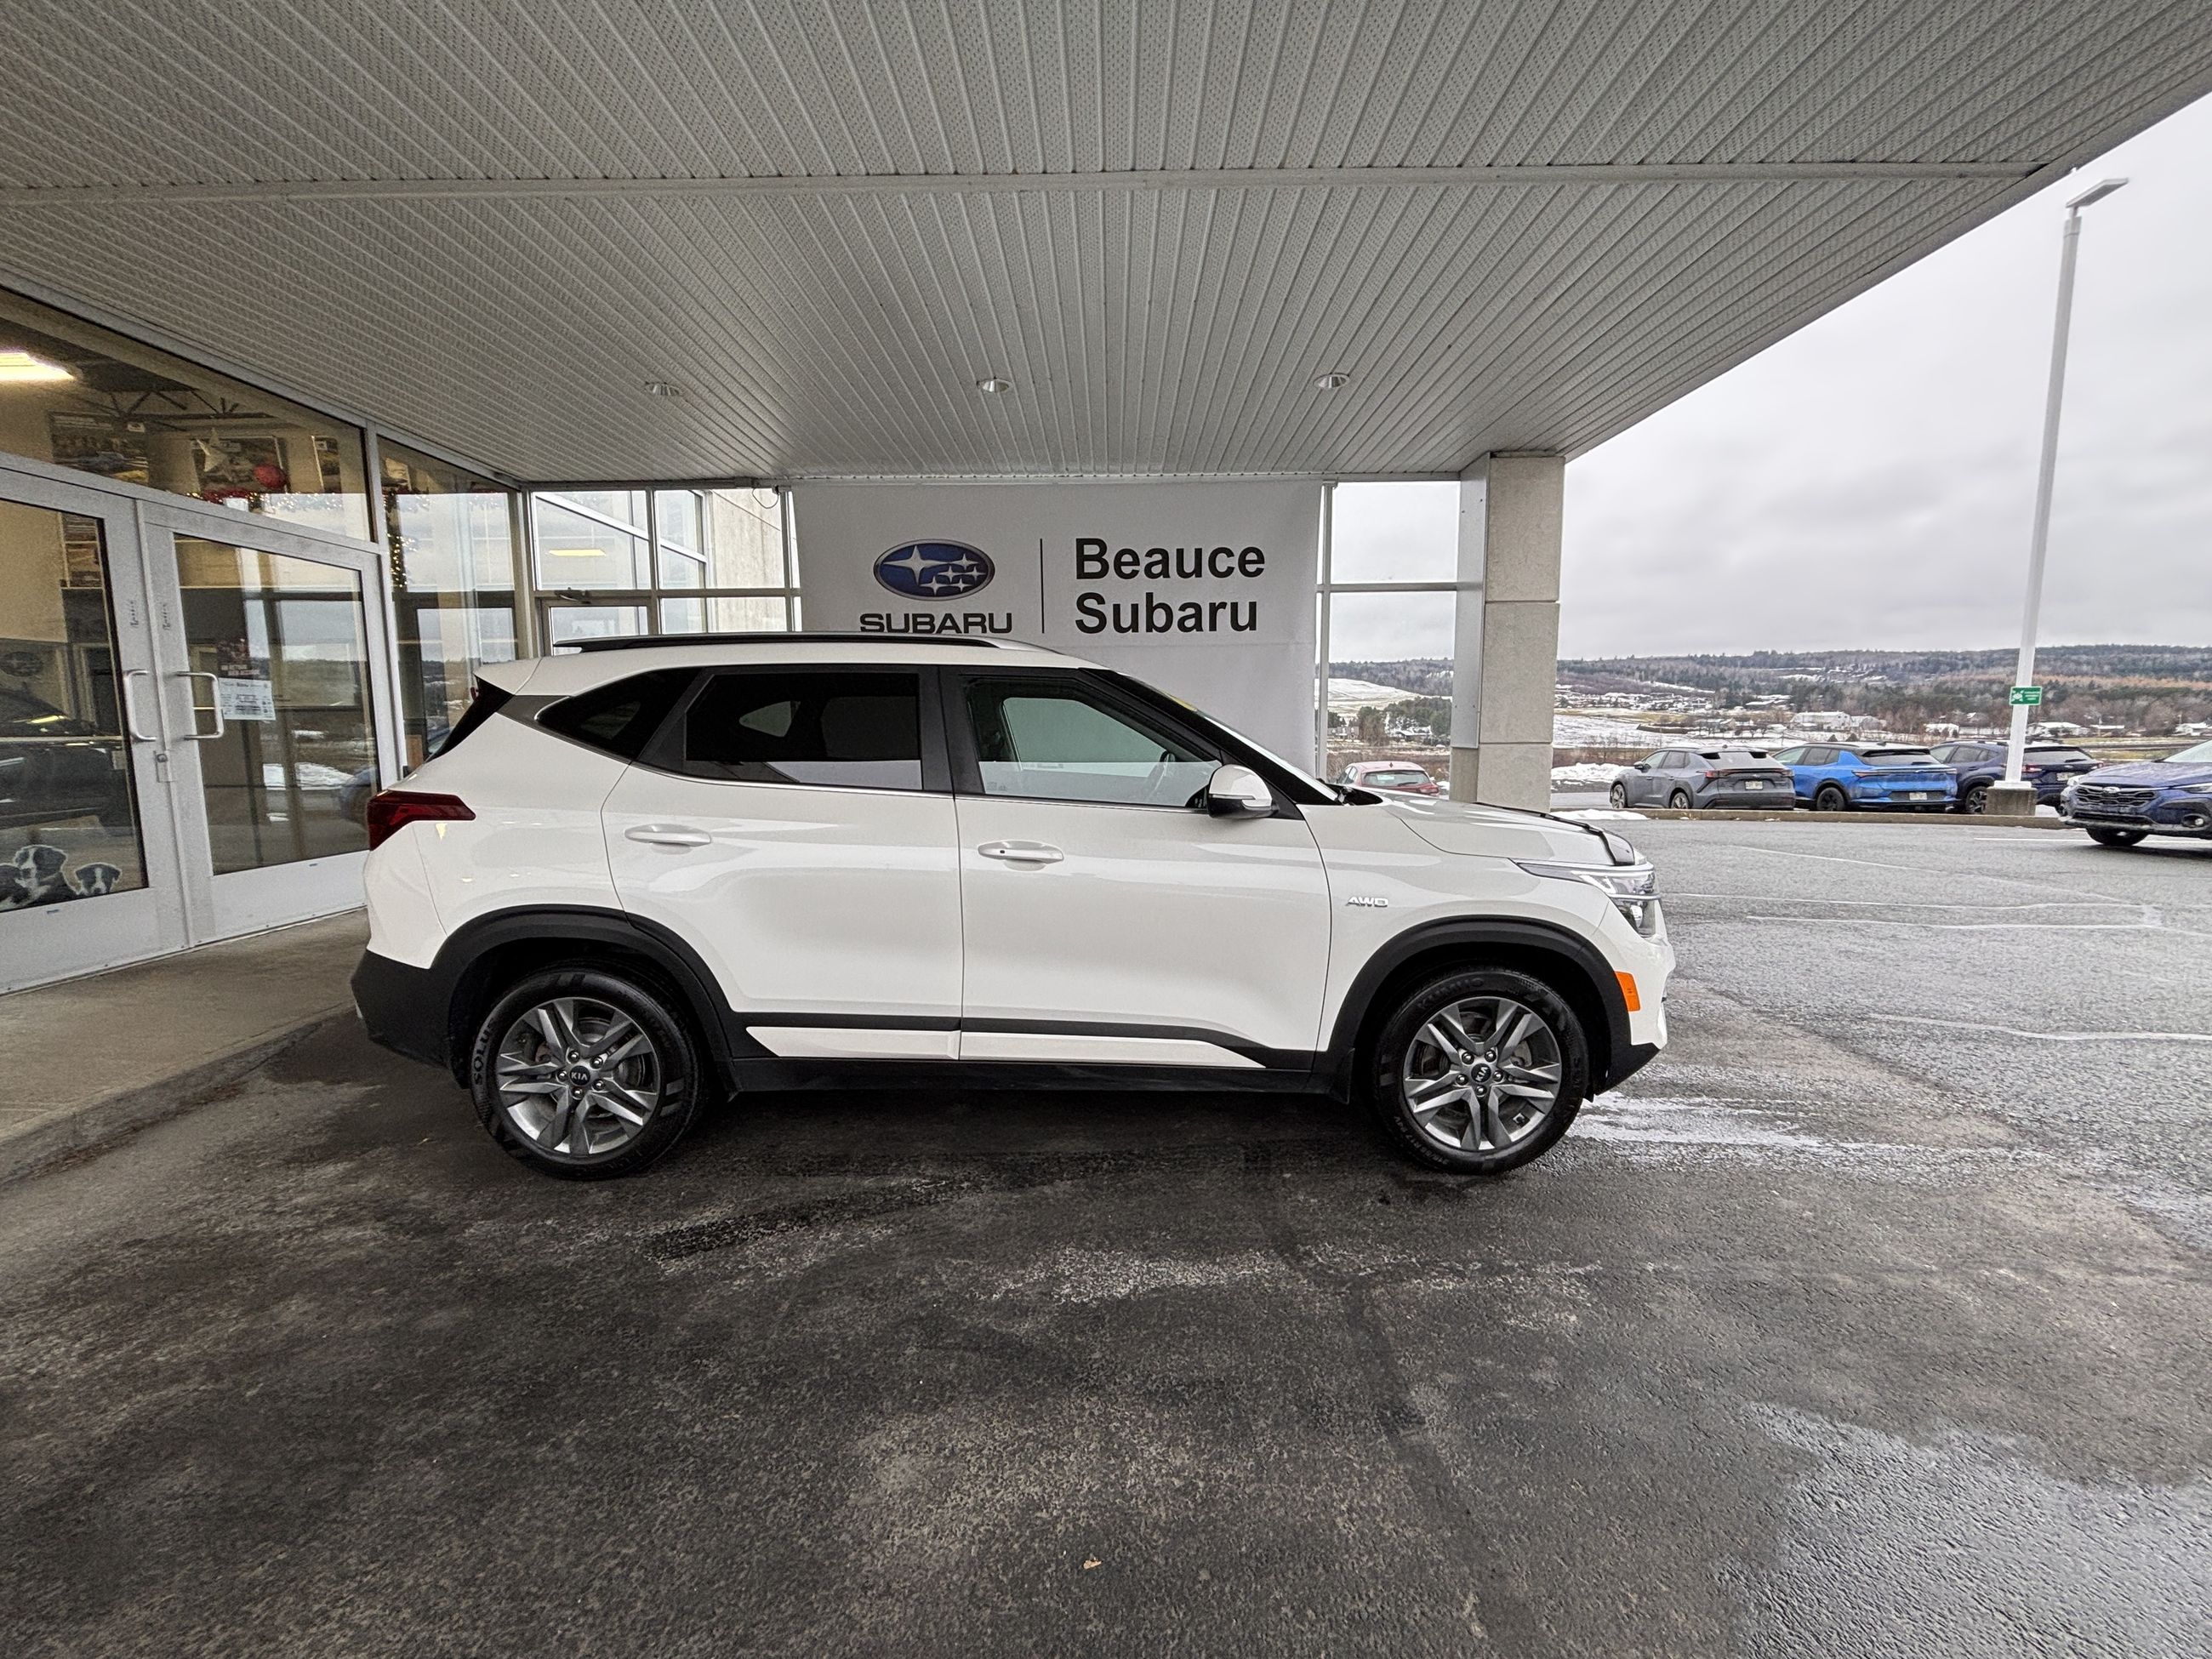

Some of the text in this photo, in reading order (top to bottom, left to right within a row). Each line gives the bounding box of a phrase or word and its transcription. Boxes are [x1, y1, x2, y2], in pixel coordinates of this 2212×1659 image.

[1075, 538, 1265, 580] Beauce
[1075, 592, 1258, 635] Subaru
[859, 613, 1012, 635] SUBARU
[1346, 896, 1388, 908] AWD
[571, 1071, 588, 1080] KIA
[1475, 1066, 1489, 1081] KIA
